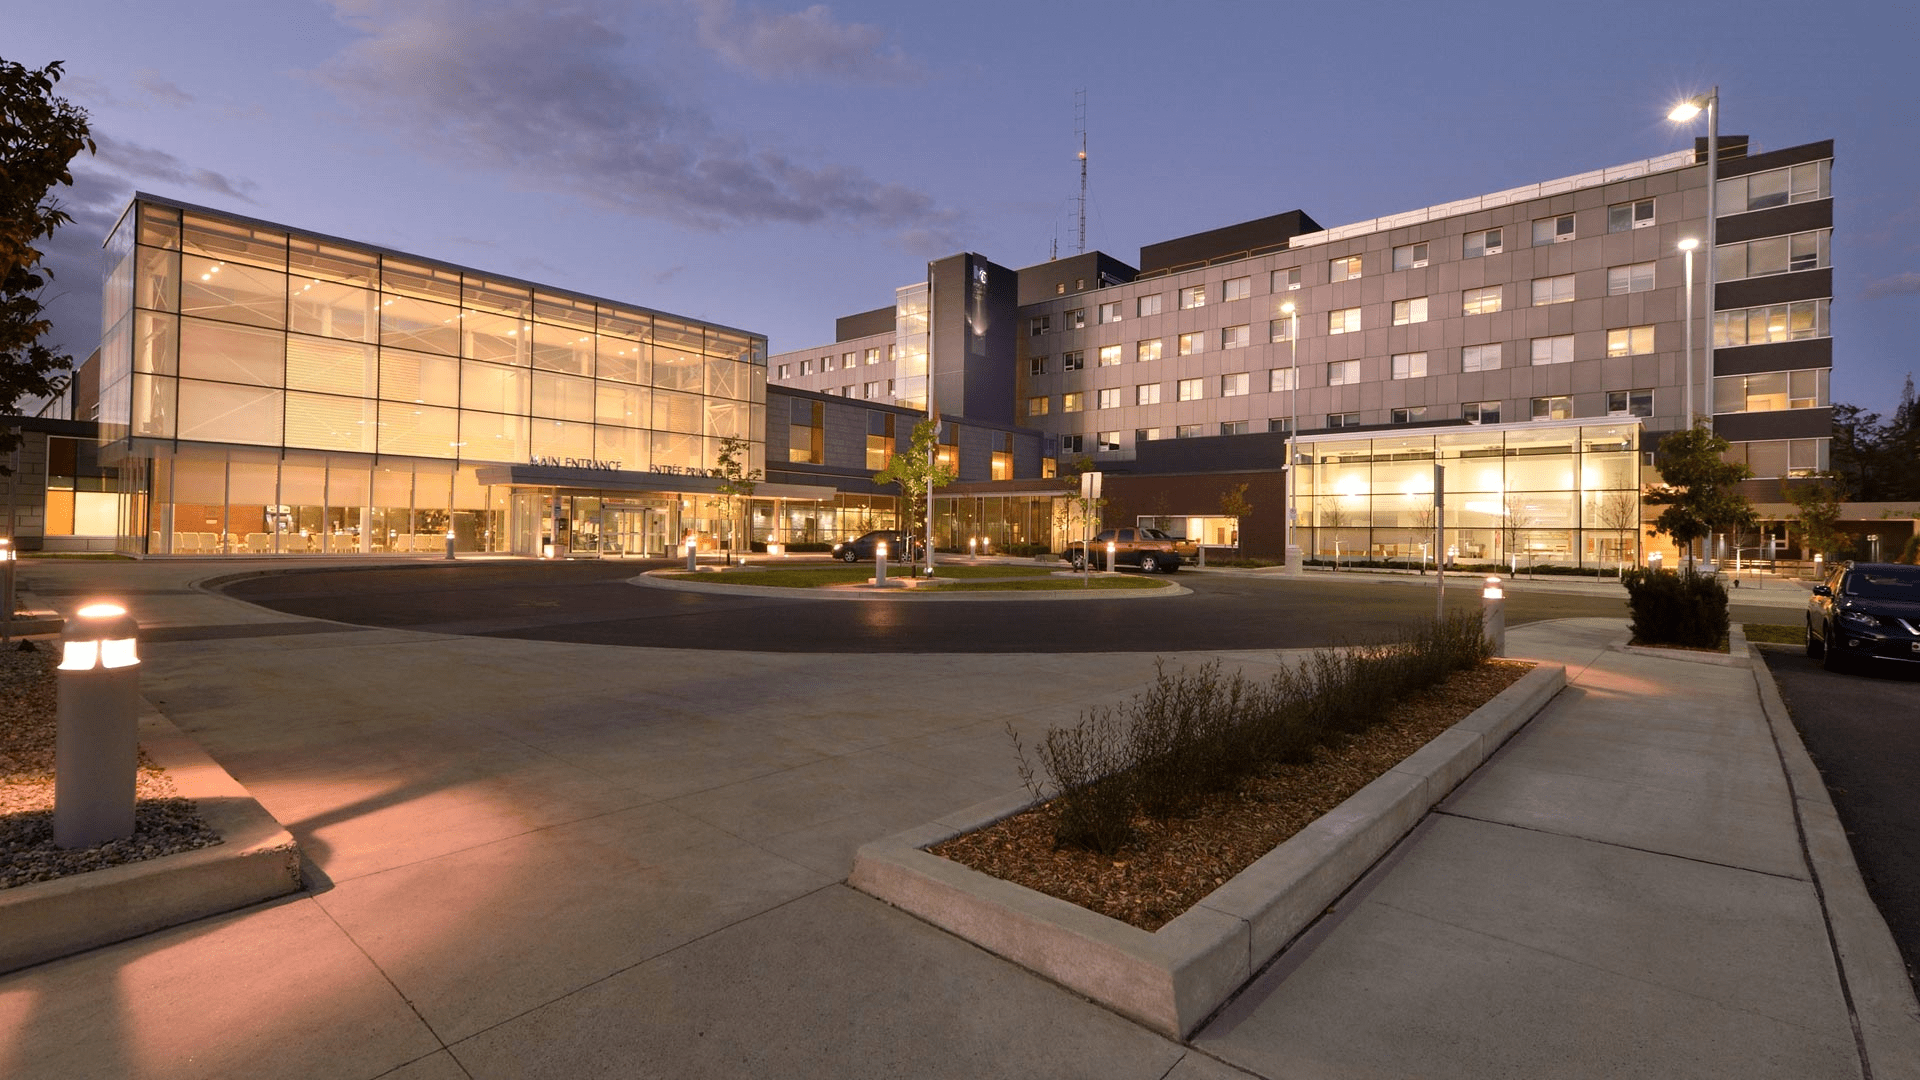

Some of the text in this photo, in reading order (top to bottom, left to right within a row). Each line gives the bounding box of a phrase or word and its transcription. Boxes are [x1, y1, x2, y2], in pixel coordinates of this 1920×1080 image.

[530, 455, 622, 472] MAIN ENTRANCE
[650, 463, 682, 476] ENTRÉE
